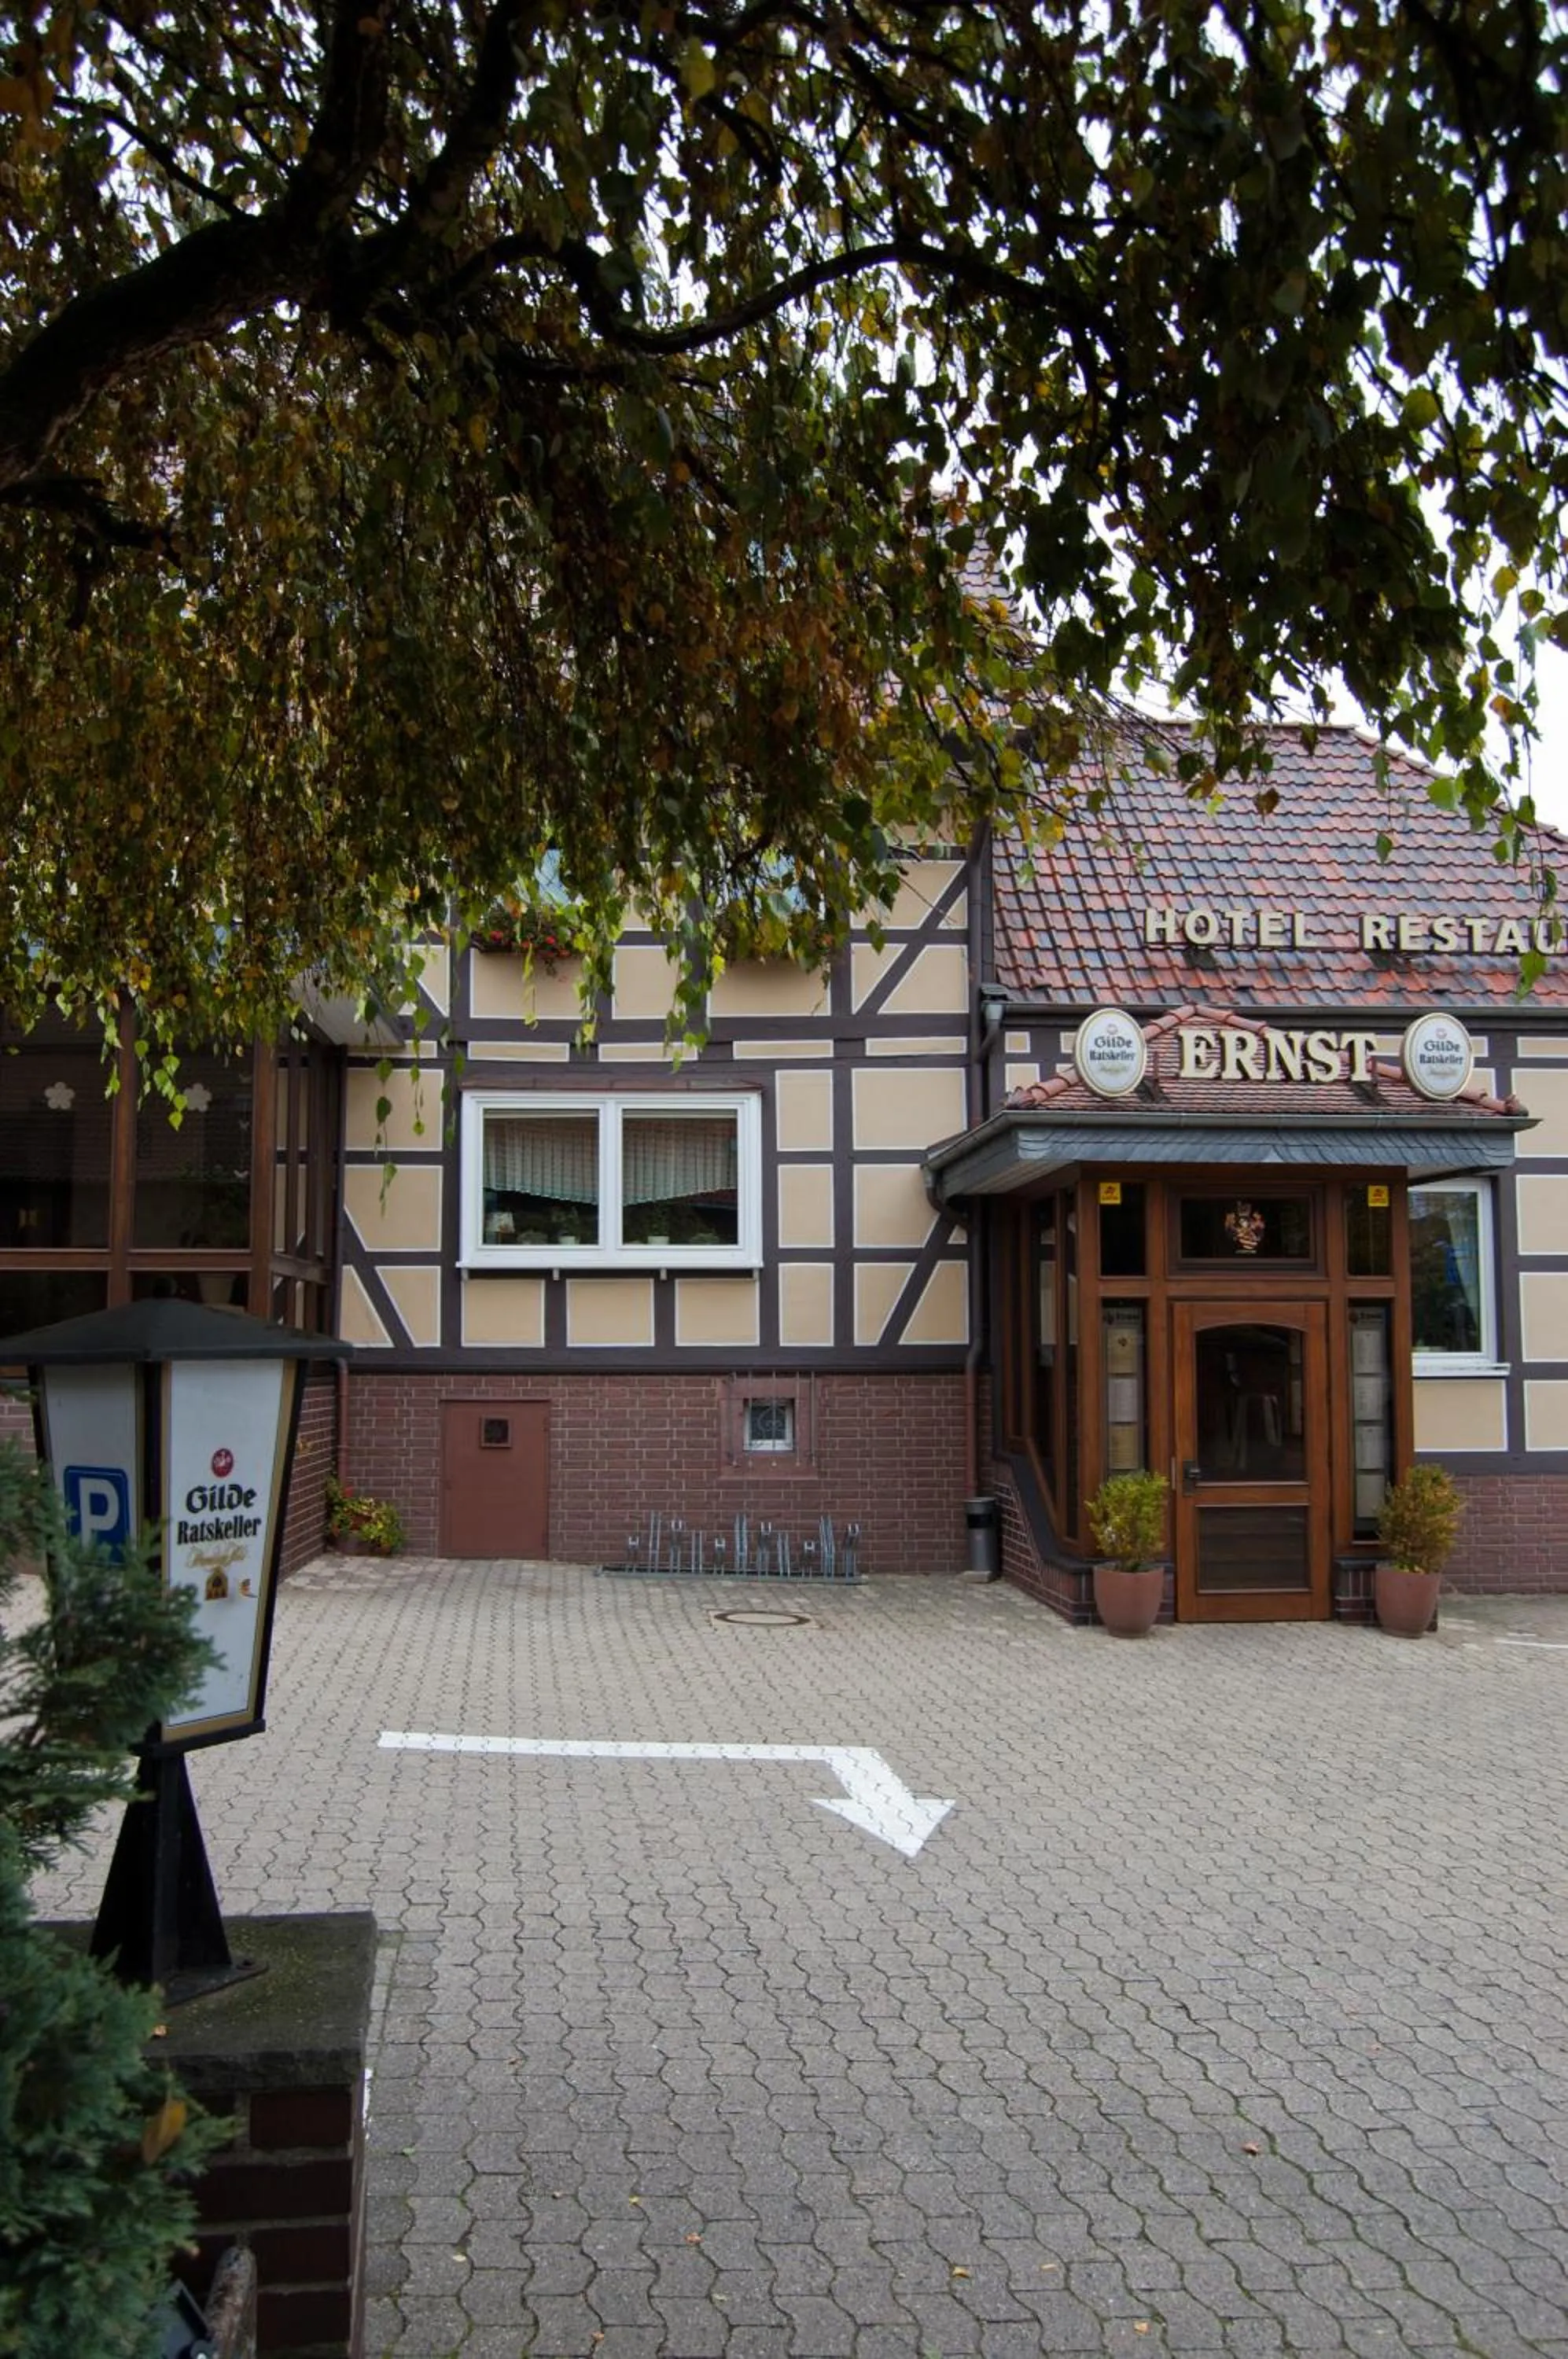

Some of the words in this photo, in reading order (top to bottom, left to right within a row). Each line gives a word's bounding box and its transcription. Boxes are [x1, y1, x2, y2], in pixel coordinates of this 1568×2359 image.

[1145, 907, 1318, 947] HOTEL
[1094, 1036, 1132, 1048] Gilde
[1179, 1029, 1377, 1082] ERNST
[1424, 1040, 1460, 1052] Gilde
[186, 1484, 257, 1514] Gilde
[79, 1478, 120, 1551] P
[177, 1515, 262, 1545] Ratskeller
